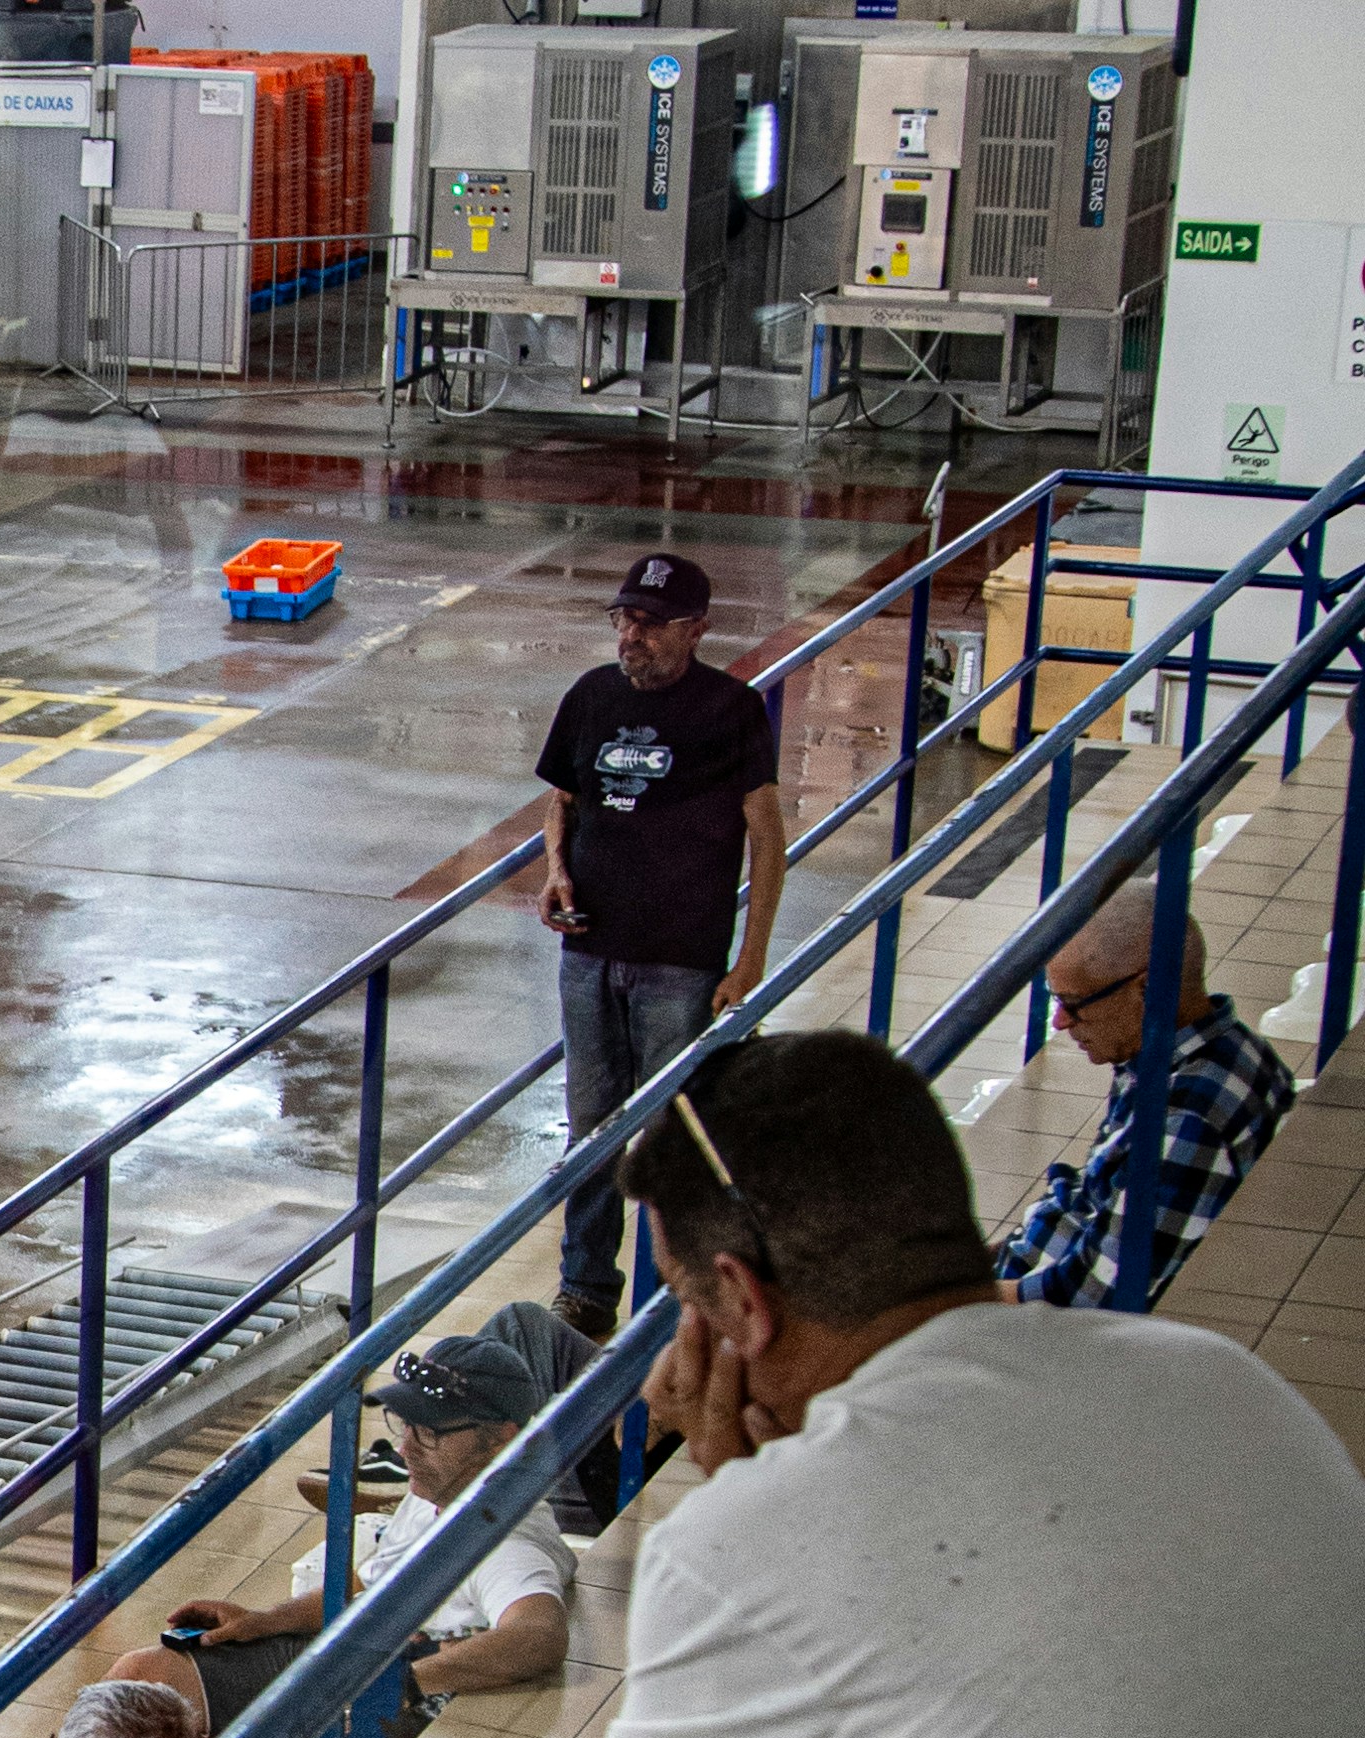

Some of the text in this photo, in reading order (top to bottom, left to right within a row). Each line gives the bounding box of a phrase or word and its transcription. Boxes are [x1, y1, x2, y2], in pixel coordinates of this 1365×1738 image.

[4, 96, 21, 110] DE
[24, 95, 74, 111] CAIXAS
[657, 93, 672, 119] ICE
[1096, 105, 1112, 132] ICE
[652, 123, 671, 196] SYSTEMS
[1089, 138, 1109, 212] SYSTEMS
[1182, 229, 1233, 254] SAIDA
[1353, 340, 1365, 353] C
[1233, 454, 1269, 467] Perigo
